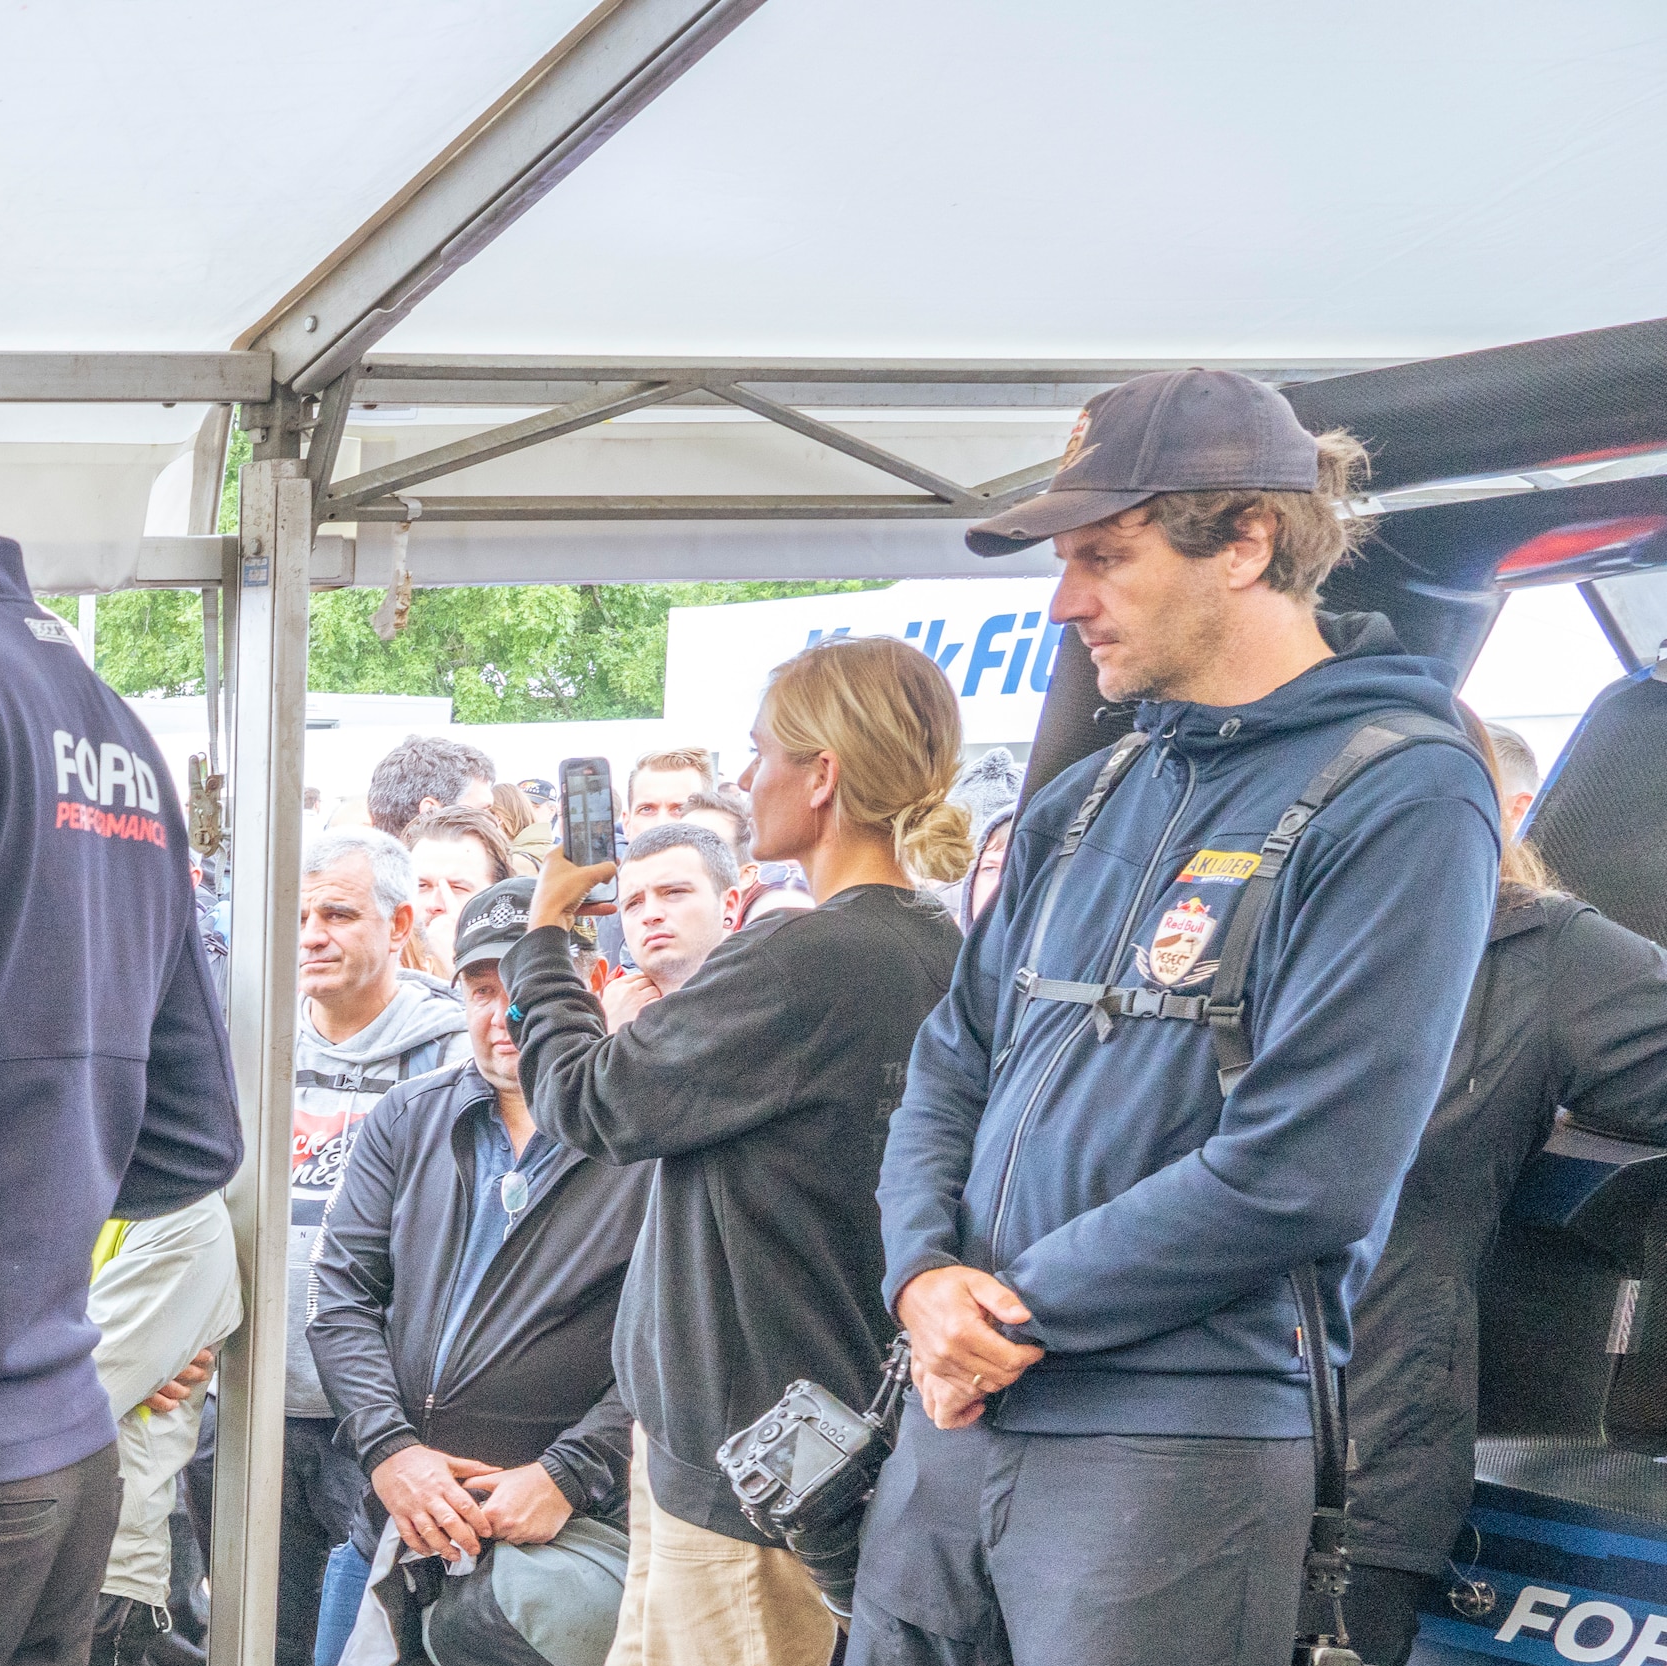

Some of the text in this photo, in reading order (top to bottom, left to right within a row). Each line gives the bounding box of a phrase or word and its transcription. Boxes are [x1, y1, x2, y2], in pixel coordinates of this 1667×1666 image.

[53, 730, 160, 814] FORD
[1165, 916, 1206, 934] Red Bull
[292, 1163, 343, 1186] nes
